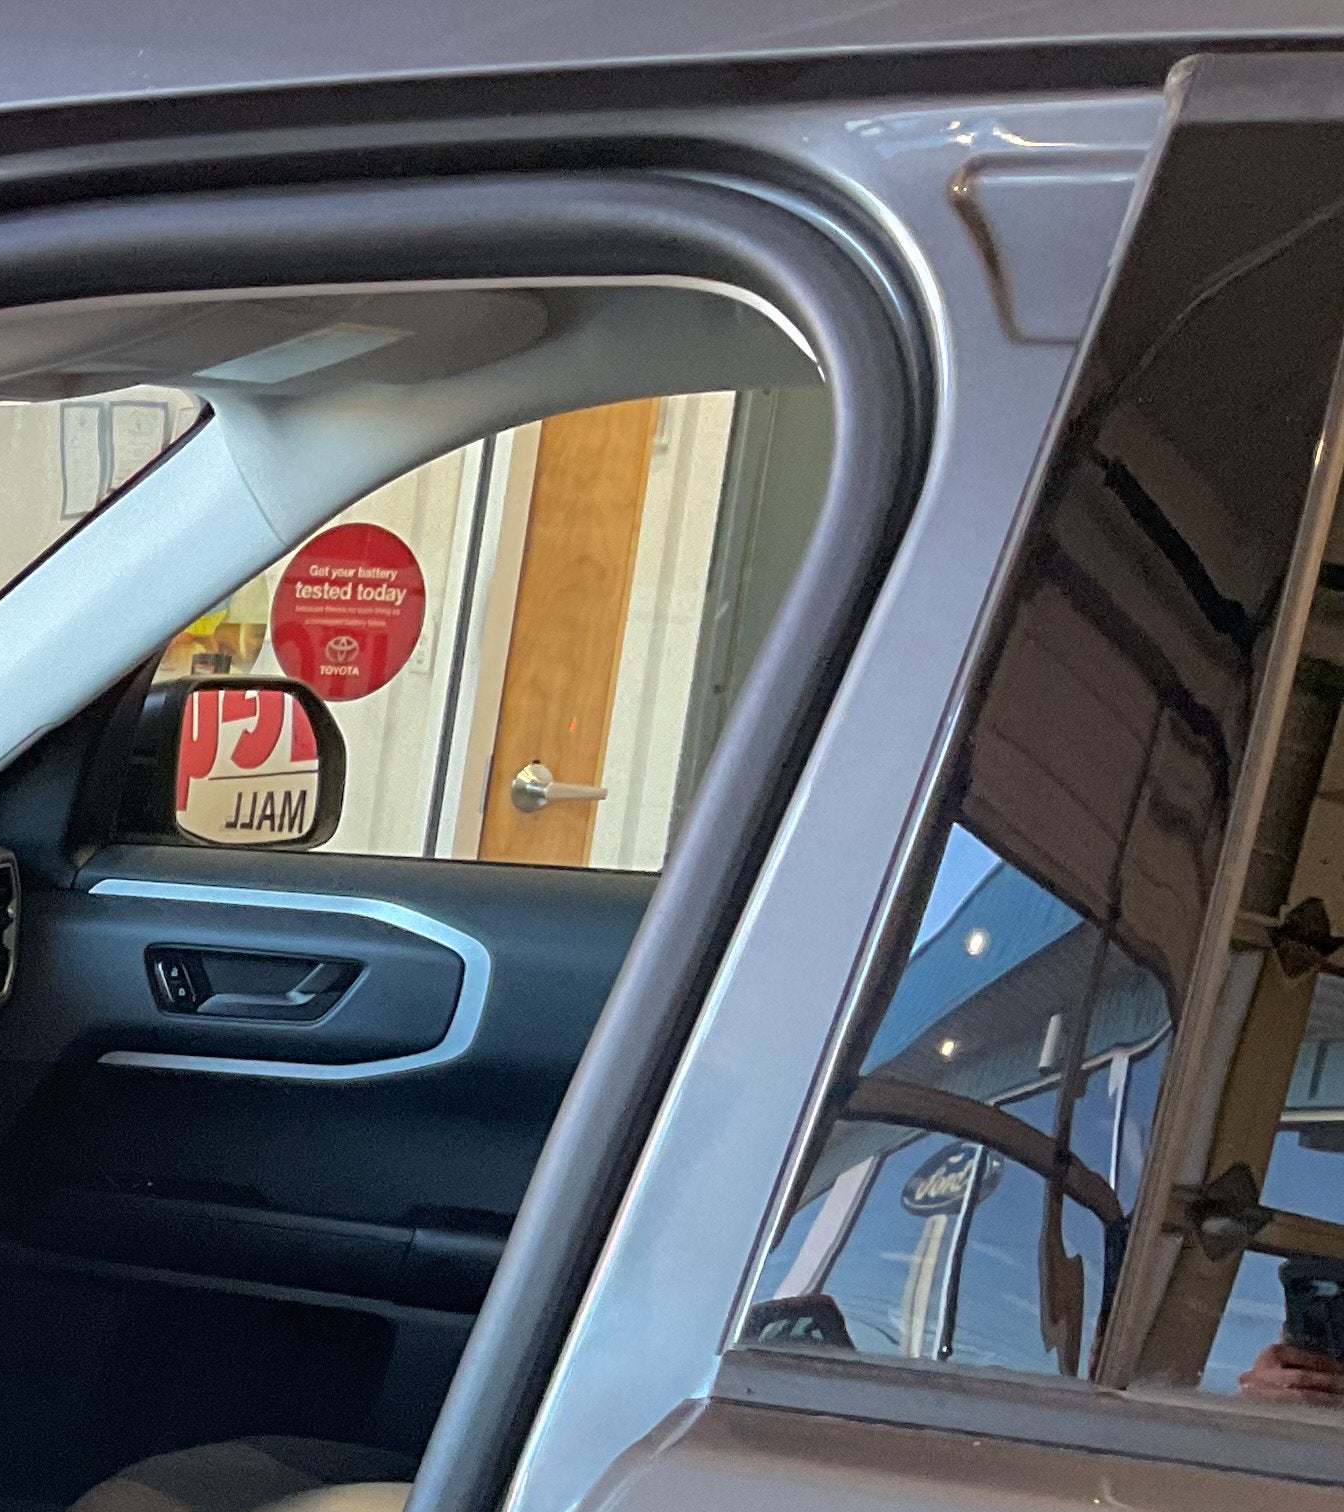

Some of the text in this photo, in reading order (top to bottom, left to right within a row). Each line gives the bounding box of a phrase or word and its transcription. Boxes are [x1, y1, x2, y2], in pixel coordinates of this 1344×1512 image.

[309, 565, 398, 582] Get your battery
[295, 581, 408, 606] tested today
[320, 665, 359, 676] TOYOTA
